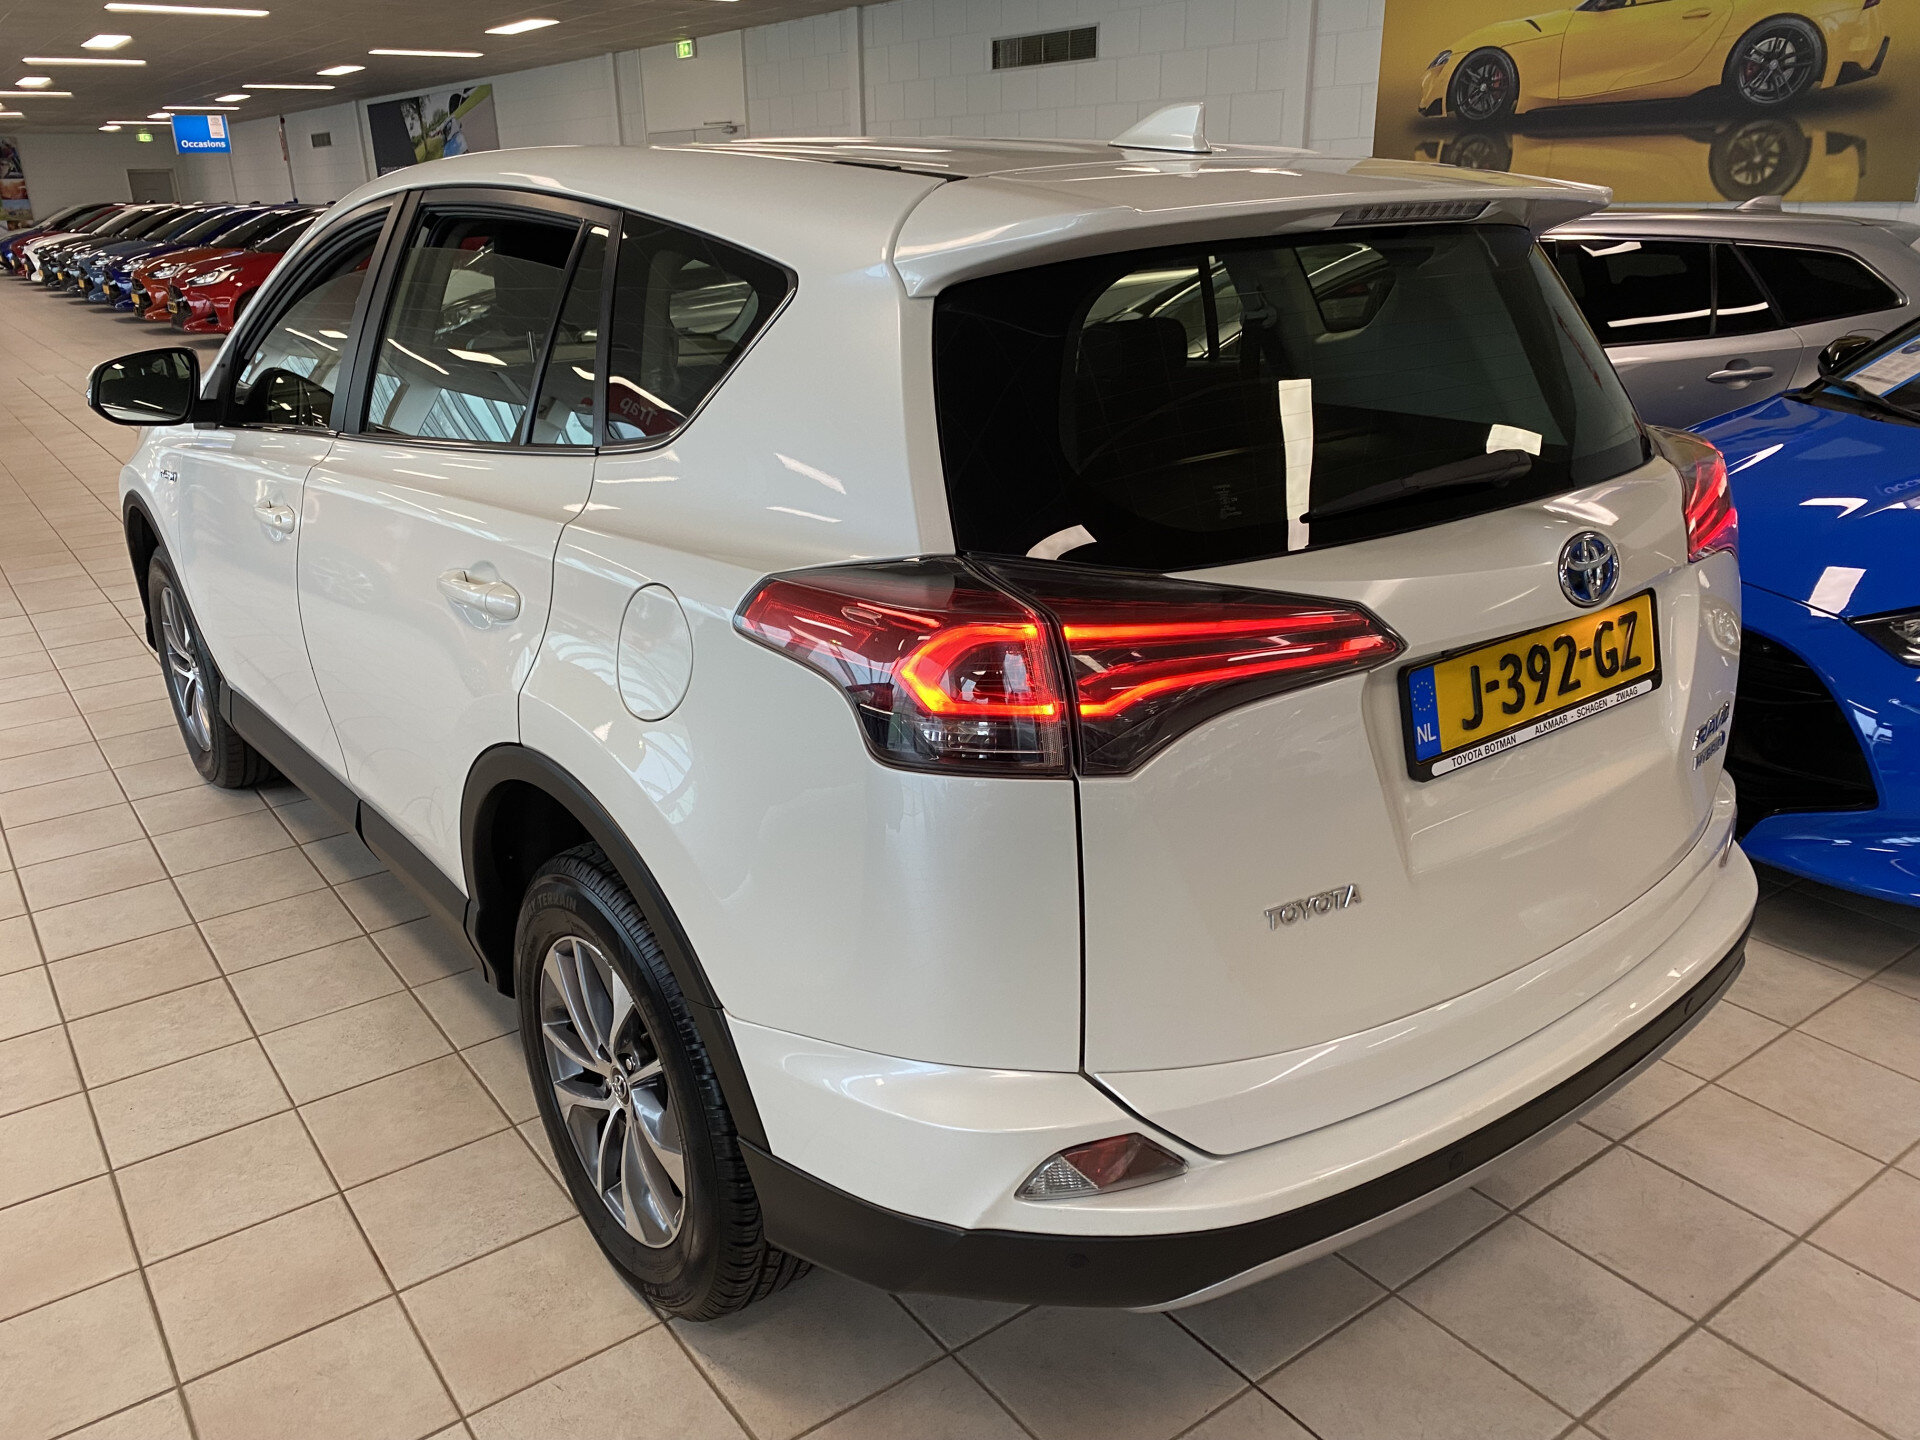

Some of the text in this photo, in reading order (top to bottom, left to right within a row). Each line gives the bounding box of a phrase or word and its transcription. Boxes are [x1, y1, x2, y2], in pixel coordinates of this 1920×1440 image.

[181, 140, 226, 148] Occasions
[1461, 611, 1641, 731] J-392-GZ
[1534, 714, 1568, 736] ALKMAAR
[1576, 698, 1608, 718] SCHAGEN
[1616, 686, 1638, 703] ZWAAG
[1417, 723, 1437, 745] NL
[1451, 735, 1517, 768] TOYOTA BOTMAN
[1264, 884, 1361, 931] TOYOTA
